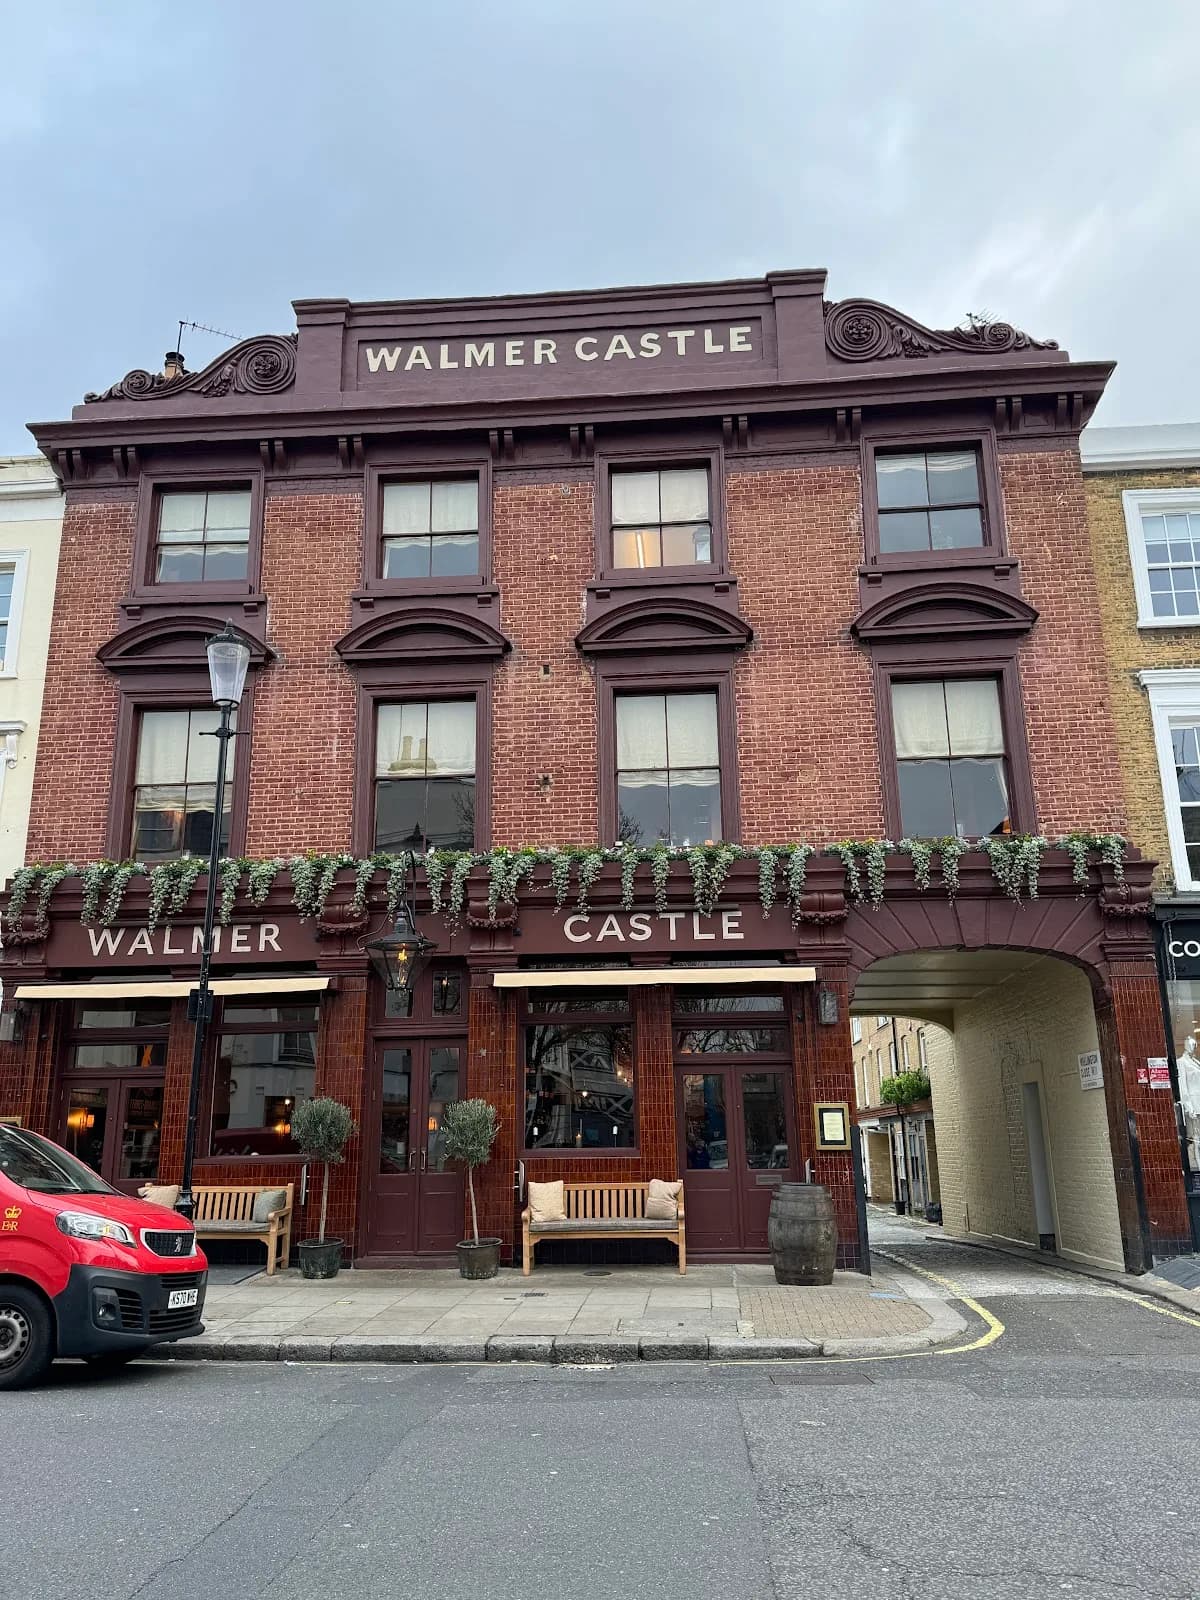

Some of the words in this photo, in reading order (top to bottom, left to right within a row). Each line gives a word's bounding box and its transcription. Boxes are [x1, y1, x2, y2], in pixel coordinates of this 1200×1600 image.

[366, 338, 558, 372] WALMER
[574, 326, 753, 361] CASTLE
[88, 923, 282, 956] WALMER
[563, 911, 744, 943] CASTLE
